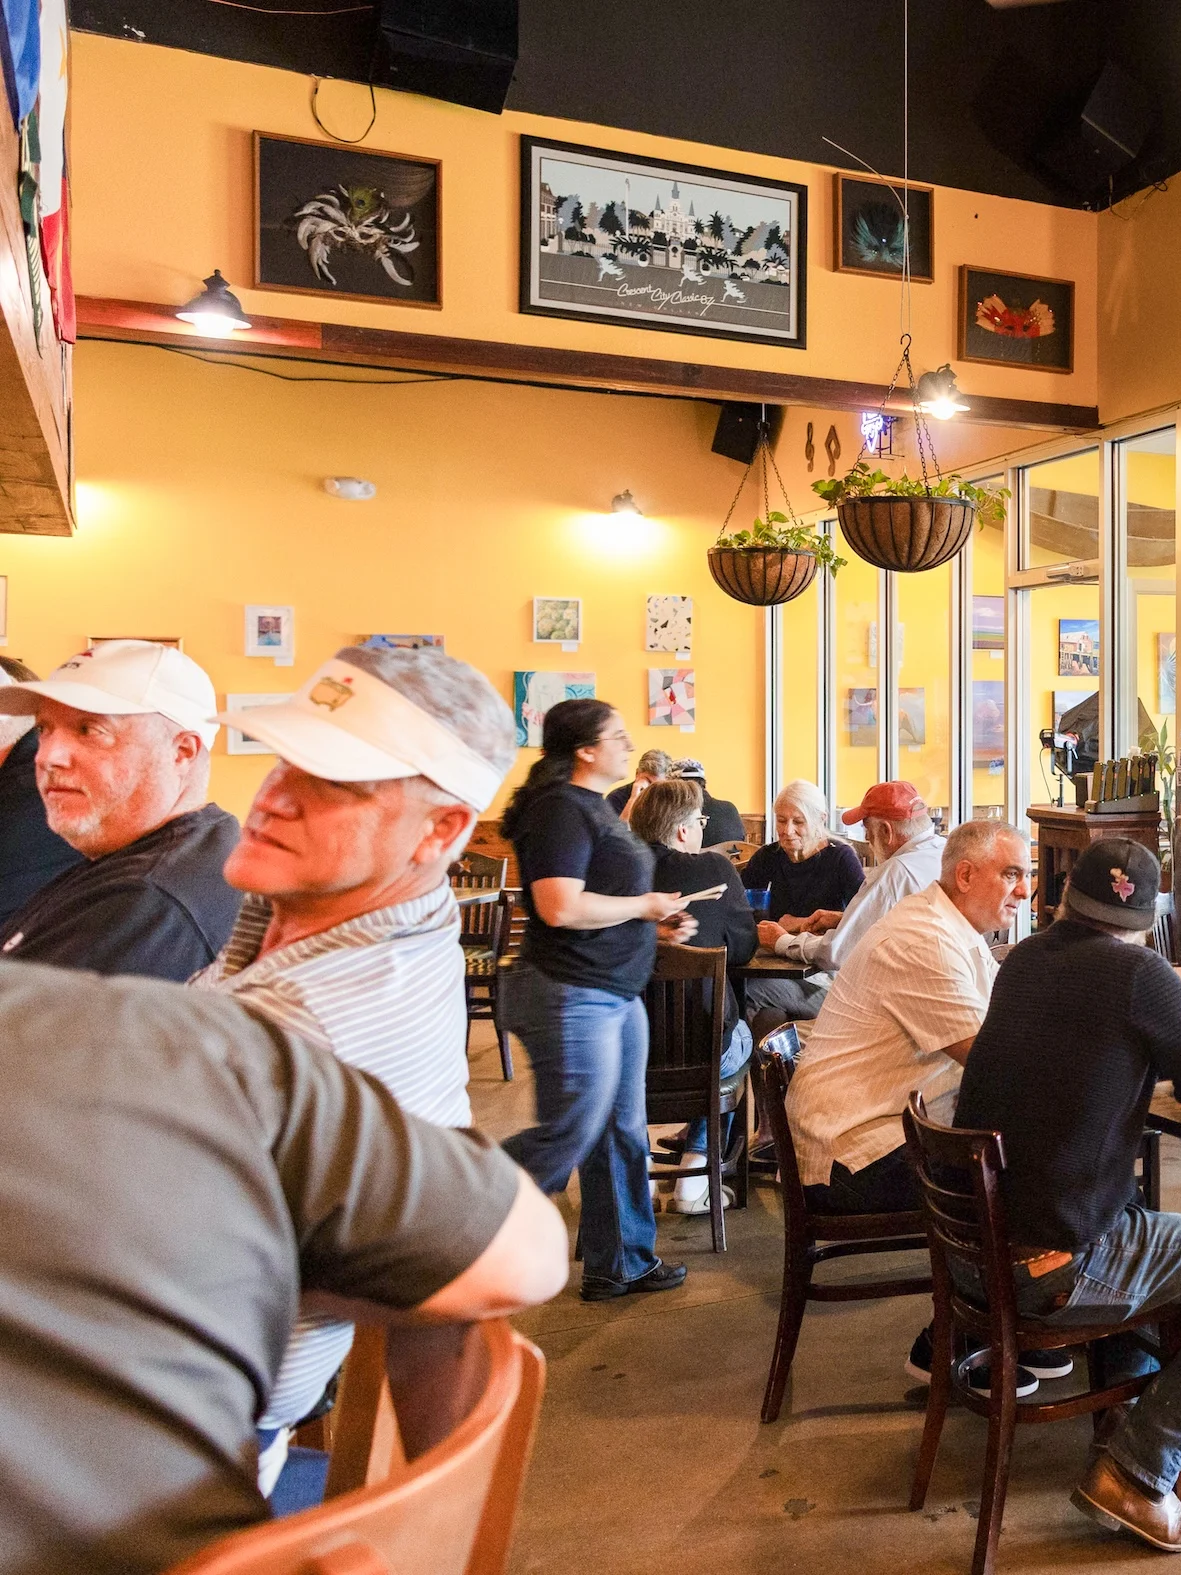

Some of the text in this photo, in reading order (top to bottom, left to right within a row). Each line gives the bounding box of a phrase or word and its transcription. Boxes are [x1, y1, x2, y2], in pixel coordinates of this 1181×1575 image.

[617, 283, 652, 297] Crescent
[651, 288, 671, 310] City
[670, 291, 701, 304] Classic
